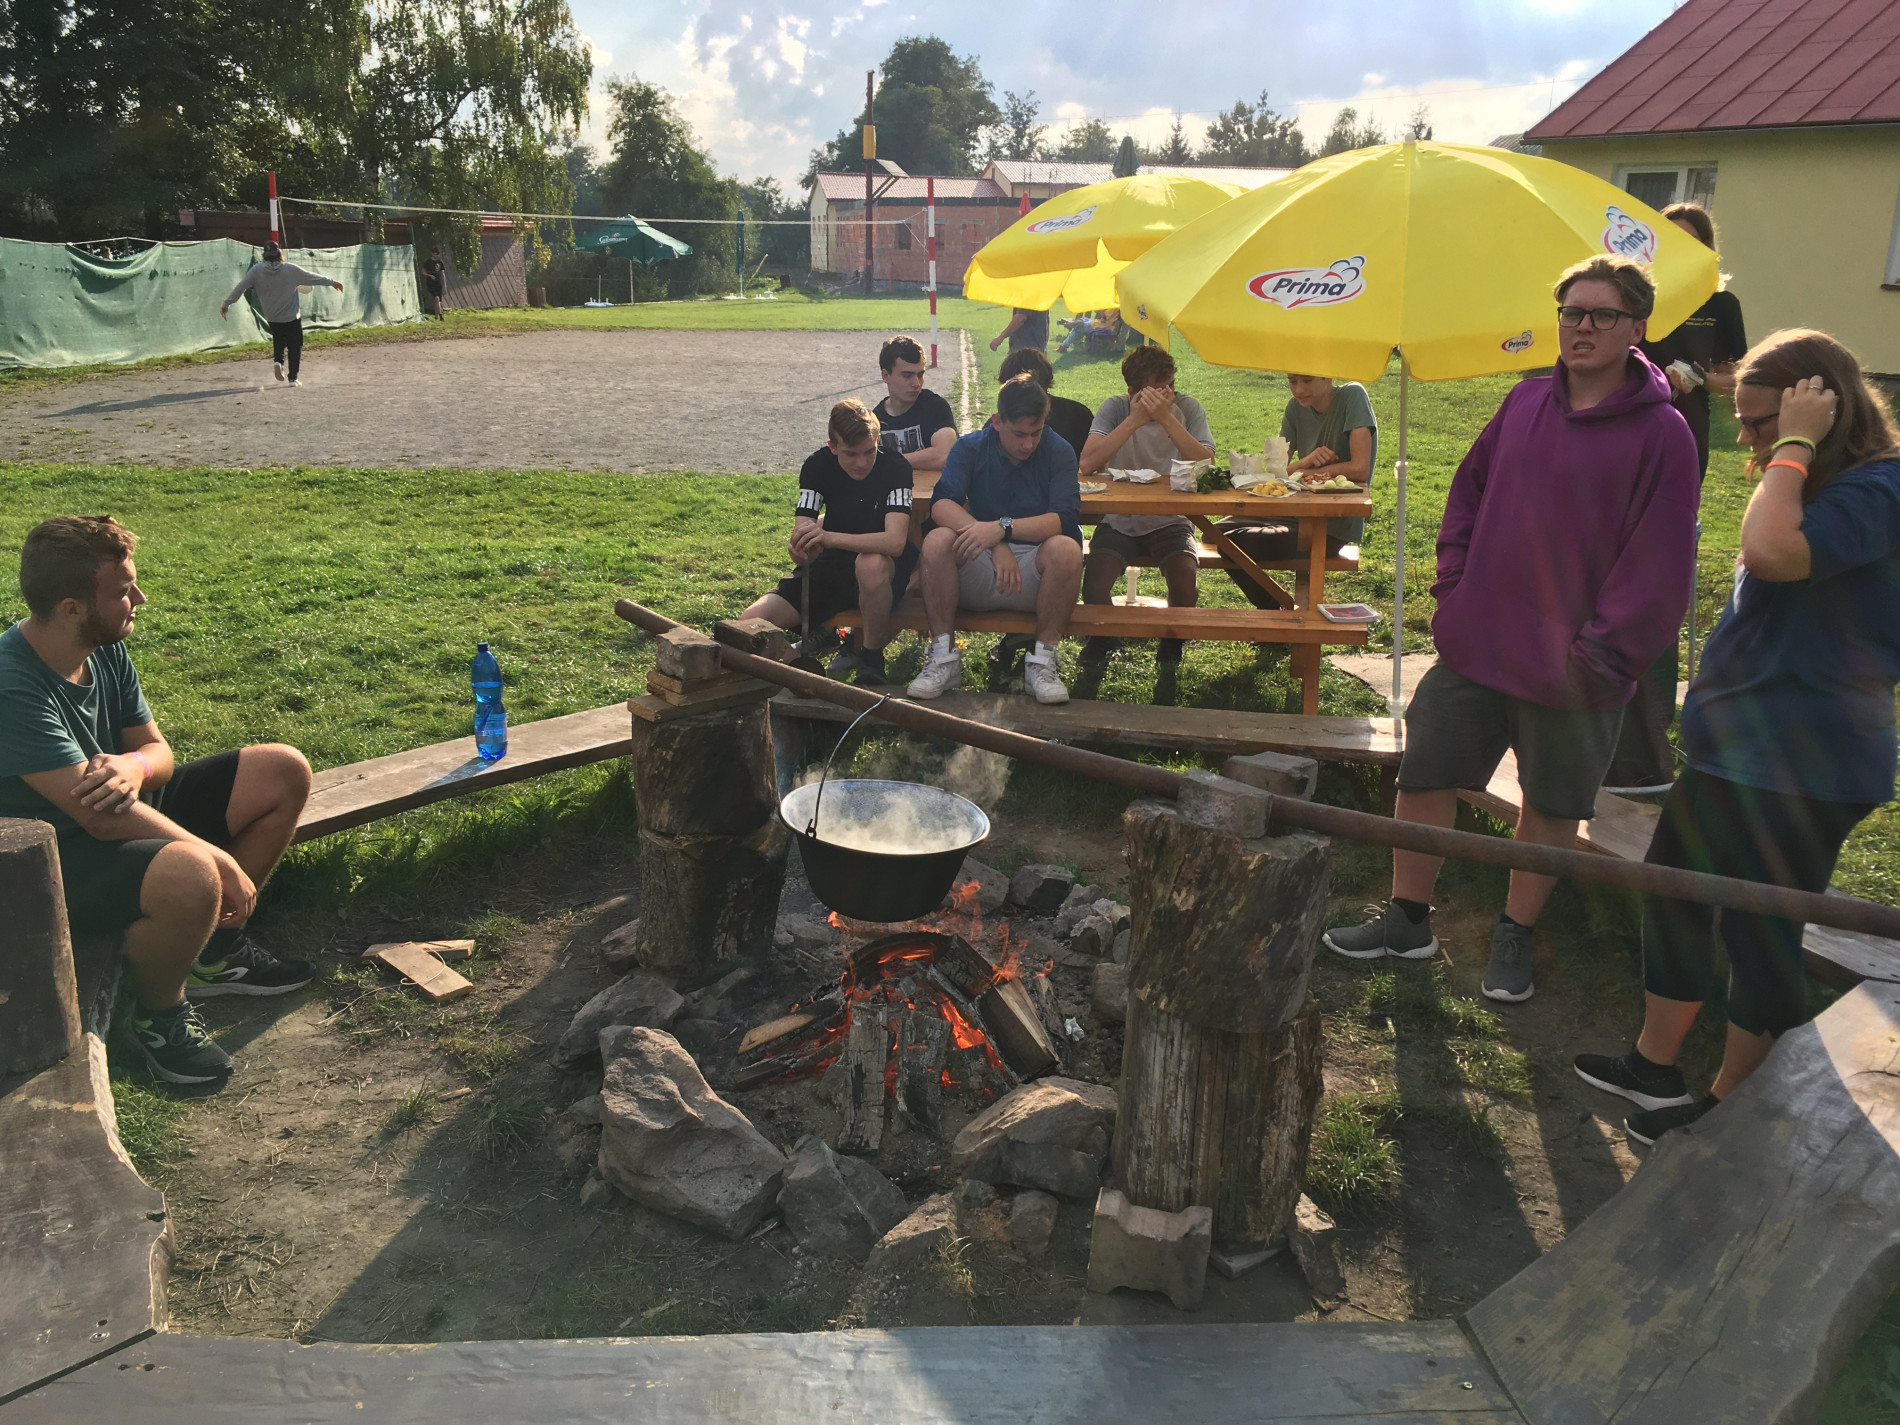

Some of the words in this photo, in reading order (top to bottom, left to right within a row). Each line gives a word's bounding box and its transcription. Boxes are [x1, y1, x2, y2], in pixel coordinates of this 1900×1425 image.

[1040, 218, 1082, 229] Prima
[1612, 228, 1648, 256] Prima
[1272, 277, 1346, 296] Prima
[1508, 340, 1529, 348] Prima
